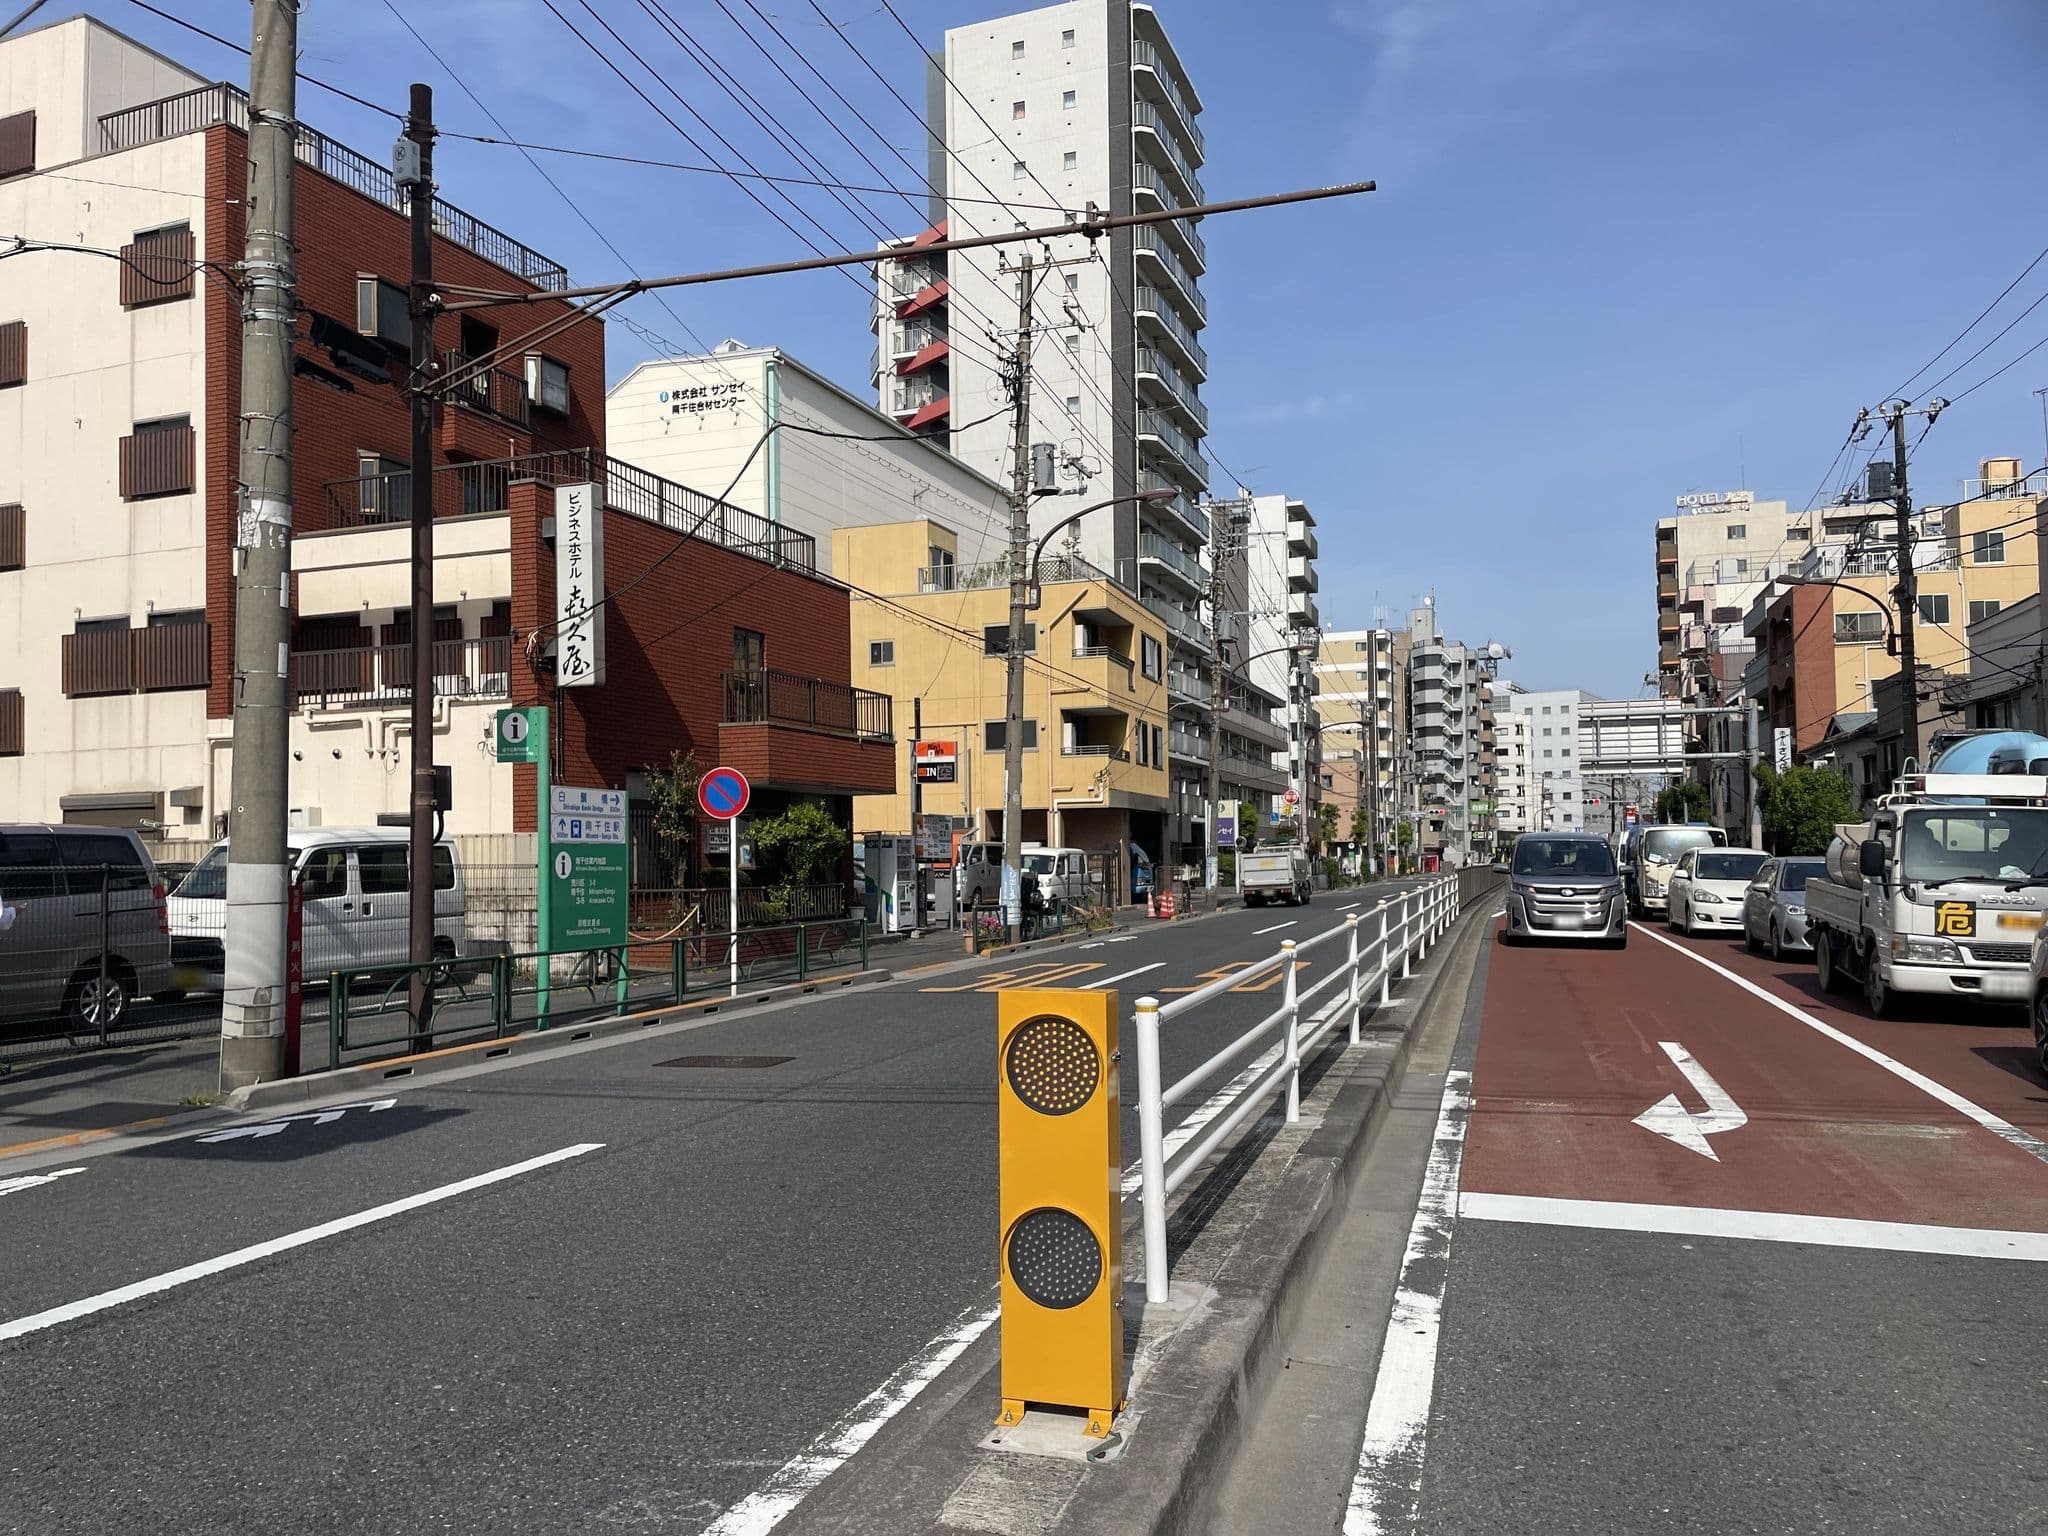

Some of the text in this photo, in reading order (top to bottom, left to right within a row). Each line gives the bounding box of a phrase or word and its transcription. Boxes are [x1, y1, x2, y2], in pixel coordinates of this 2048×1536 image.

[672, 381, 745, 401] 株式会社 サンセイ
[568, 491, 582, 579] ビジネスホテル
[586, 820, 620, 832] 南千住駅
[1981, 894, 2036, 905] ISUZU
[1937, 902, 1973, 935] 危
